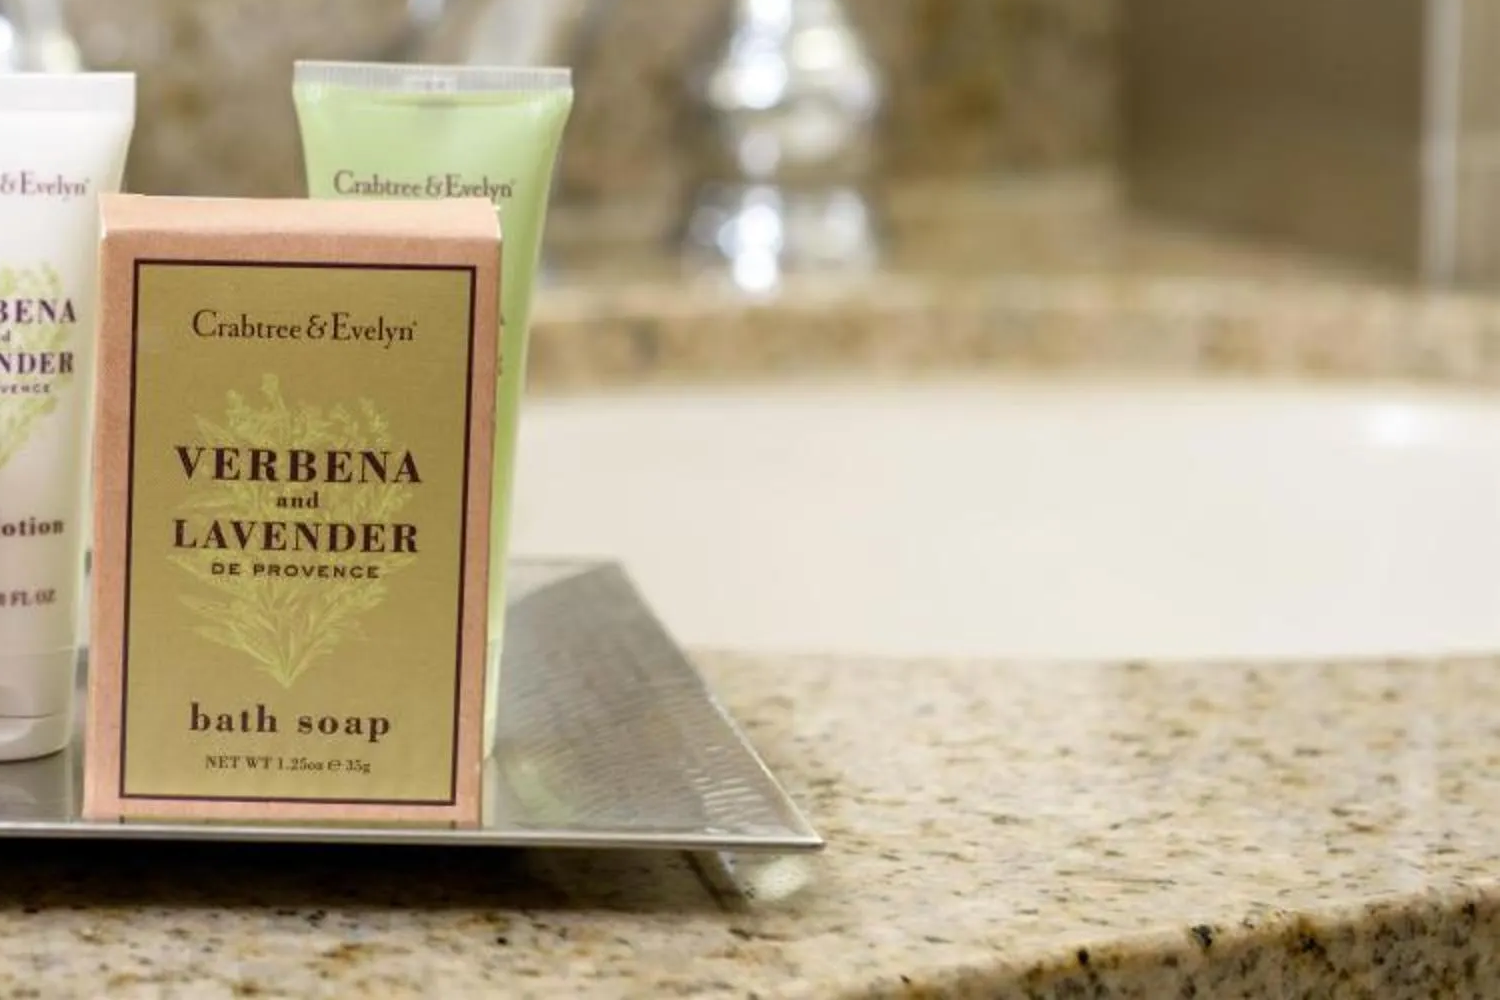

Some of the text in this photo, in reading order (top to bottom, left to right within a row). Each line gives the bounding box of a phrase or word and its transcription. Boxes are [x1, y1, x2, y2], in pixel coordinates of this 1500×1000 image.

[0, 173, 15, 195] &
[333, 170, 421, 196] Crabtree
[425, 175, 442, 198] &
[193, 309, 301, 340] Crabtree
[307, 315, 328, 340] &
[174, 445, 422, 483] VERBENA
[277, 491, 319, 509] and
[173, 519, 418, 553] LAVENDER
[211, 562, 380, 578] DE PROVENCE
[190, 702, 391, 743] bath soap
[205, 755, 240, 769] NET
[246, 756, 273, 770] WT
[346, 758, 371, 774] 35g
